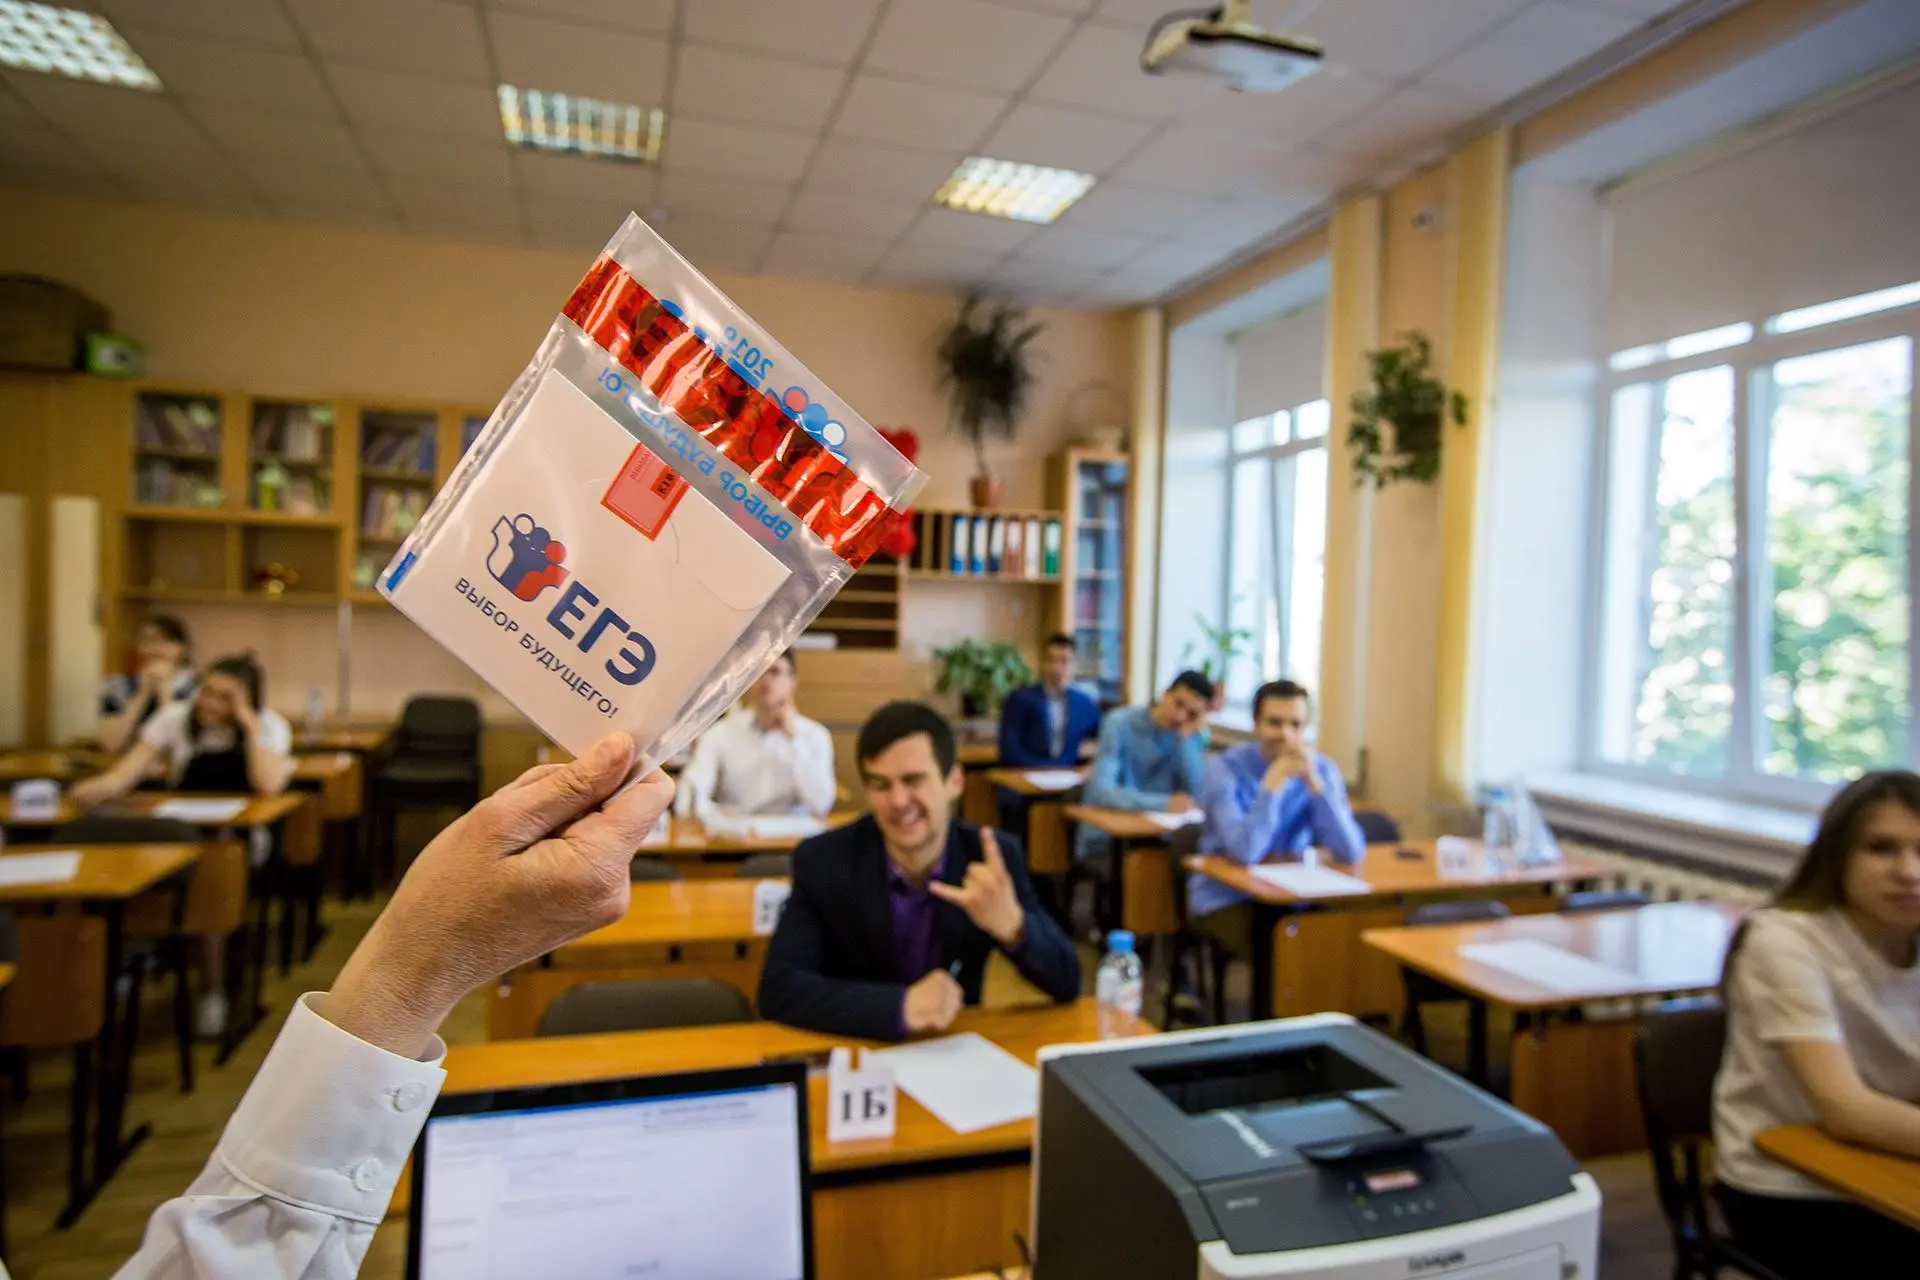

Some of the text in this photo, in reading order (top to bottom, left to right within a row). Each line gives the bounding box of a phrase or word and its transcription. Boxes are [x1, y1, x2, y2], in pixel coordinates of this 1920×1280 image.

[455, 577, 620, 719] ВЫБОР БУДУЩЕГО!
[546, 580, 657, 686] ЕГЭ
